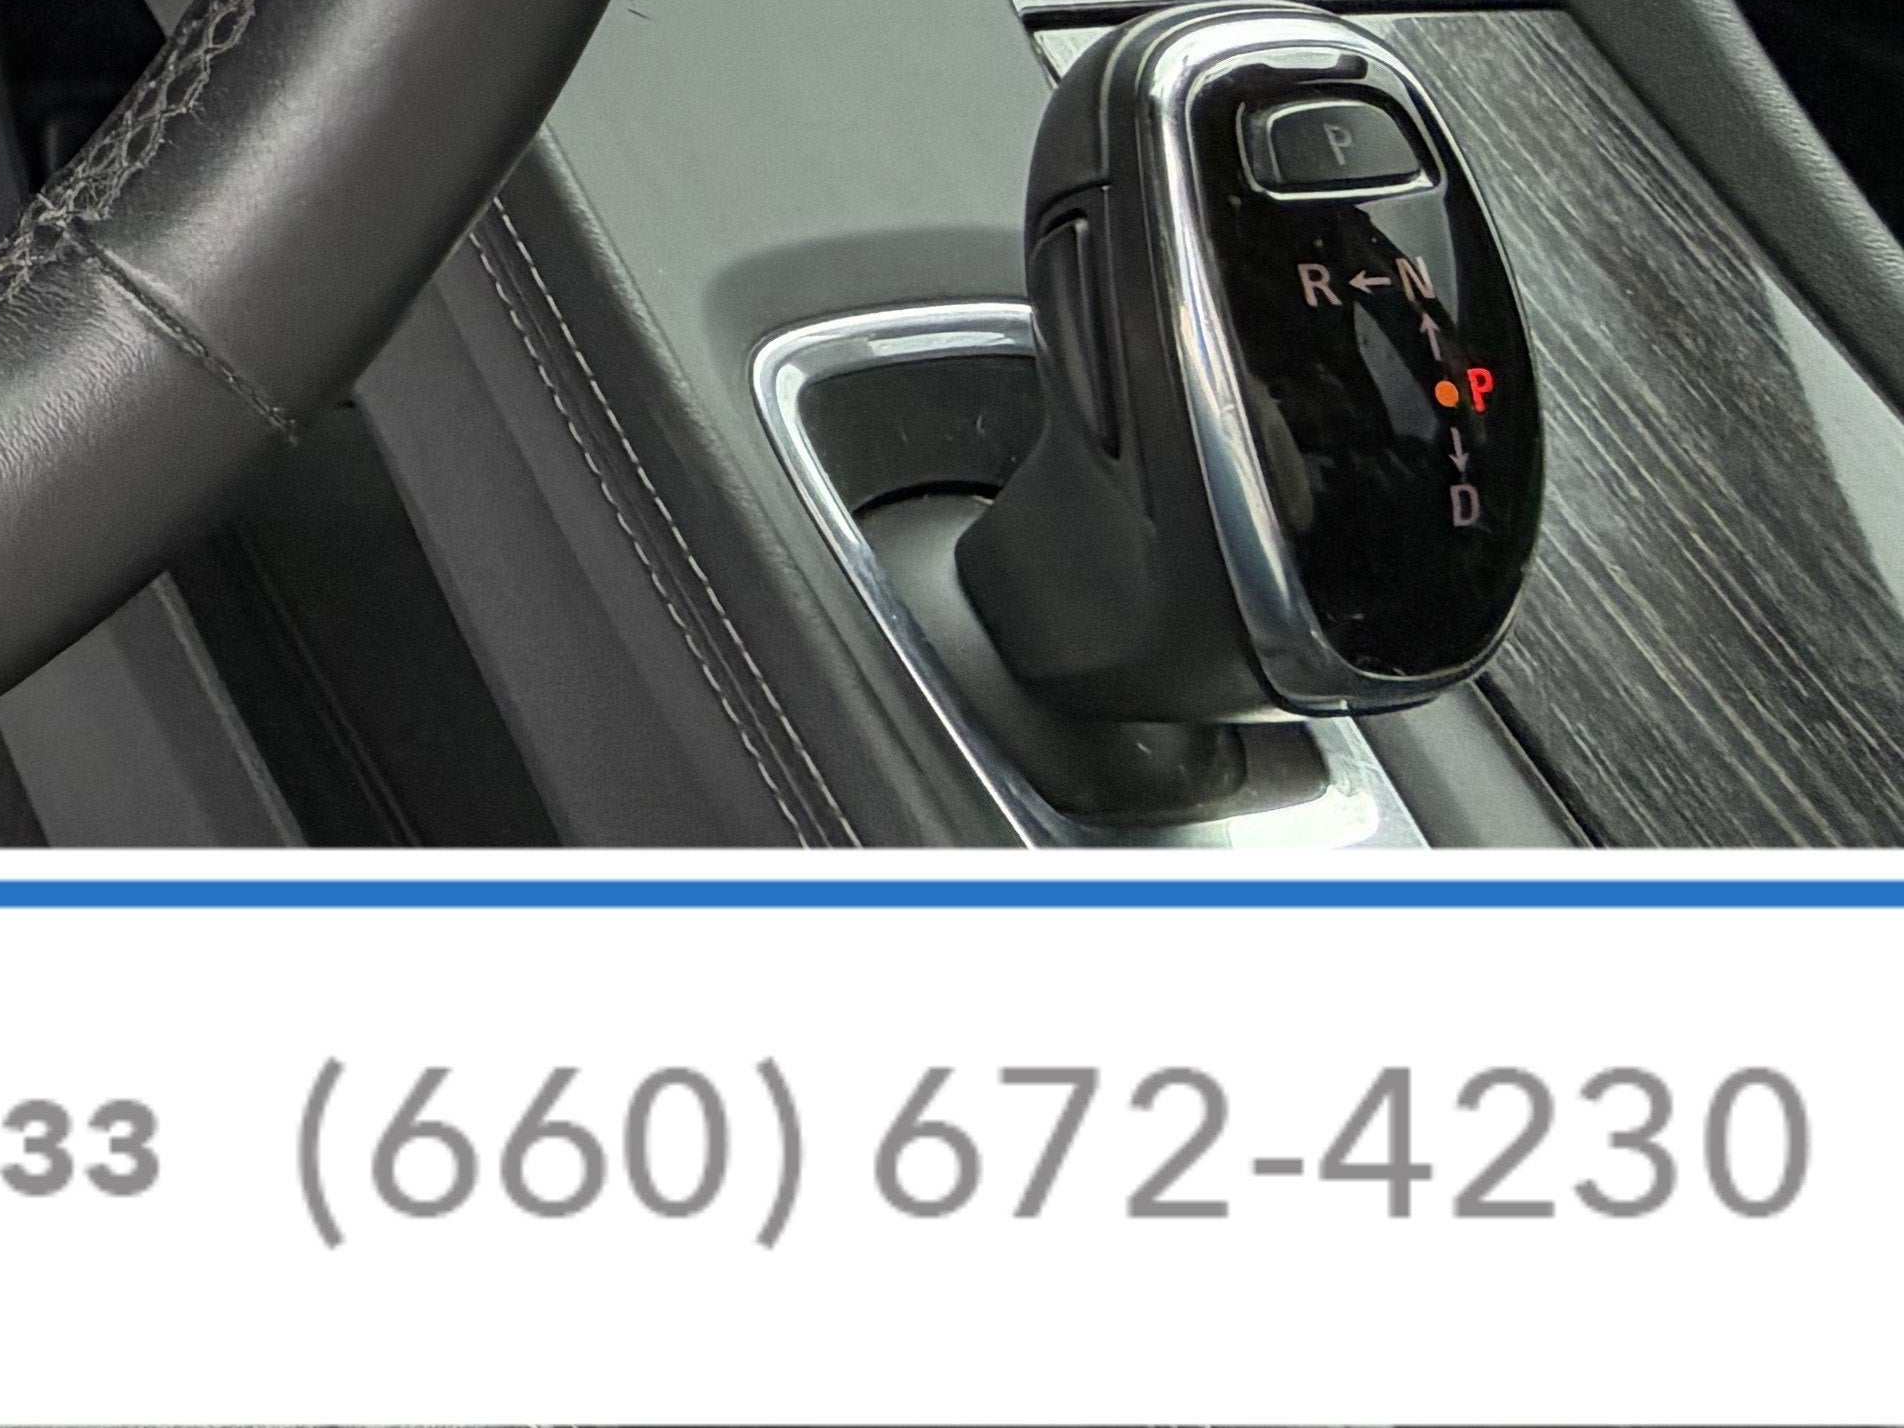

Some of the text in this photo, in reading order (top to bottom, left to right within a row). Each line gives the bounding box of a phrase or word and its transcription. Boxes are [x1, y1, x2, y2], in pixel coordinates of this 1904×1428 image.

[1323, 123, 1354, 167] P
[1297, 256, 1435, 307] R N
[1467, 368, 1494, 412] P
[1451, 484, 1480, 528] D
